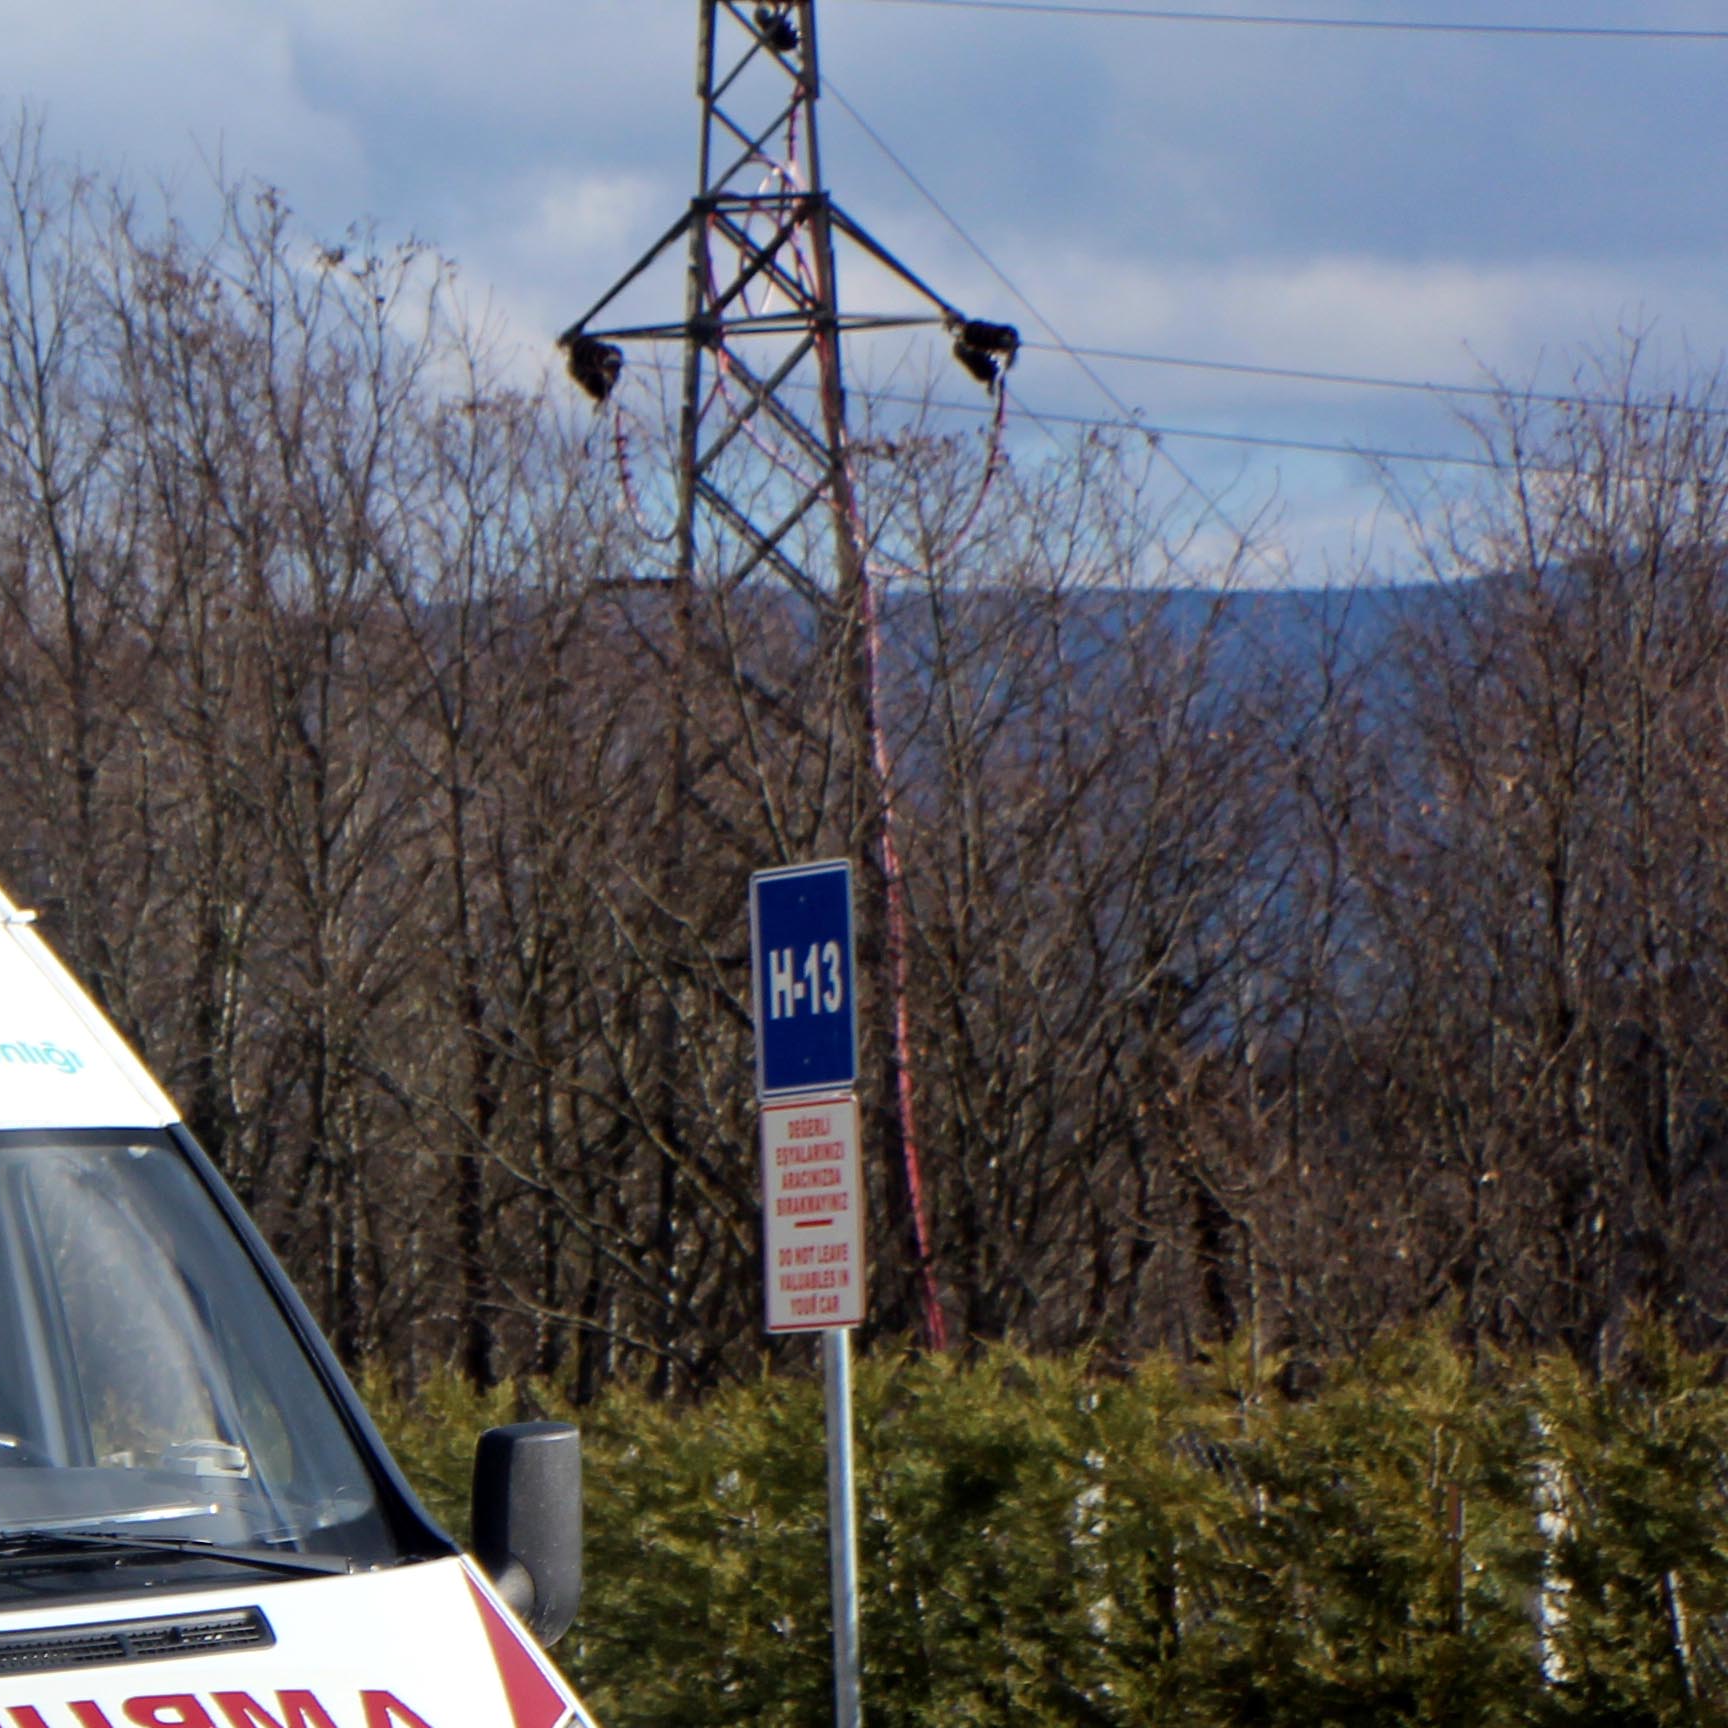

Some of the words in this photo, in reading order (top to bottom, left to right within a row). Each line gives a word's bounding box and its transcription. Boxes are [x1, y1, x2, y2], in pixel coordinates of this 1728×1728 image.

[769, 939, 843, 1020] H-13
[779, 1248, 792, 1268] DO
[818, 1243, 848, 1264] LEAVE
[779, 1269, 835, 1292] VALUABLES
[818, 1294, 840, 1314] CAR
